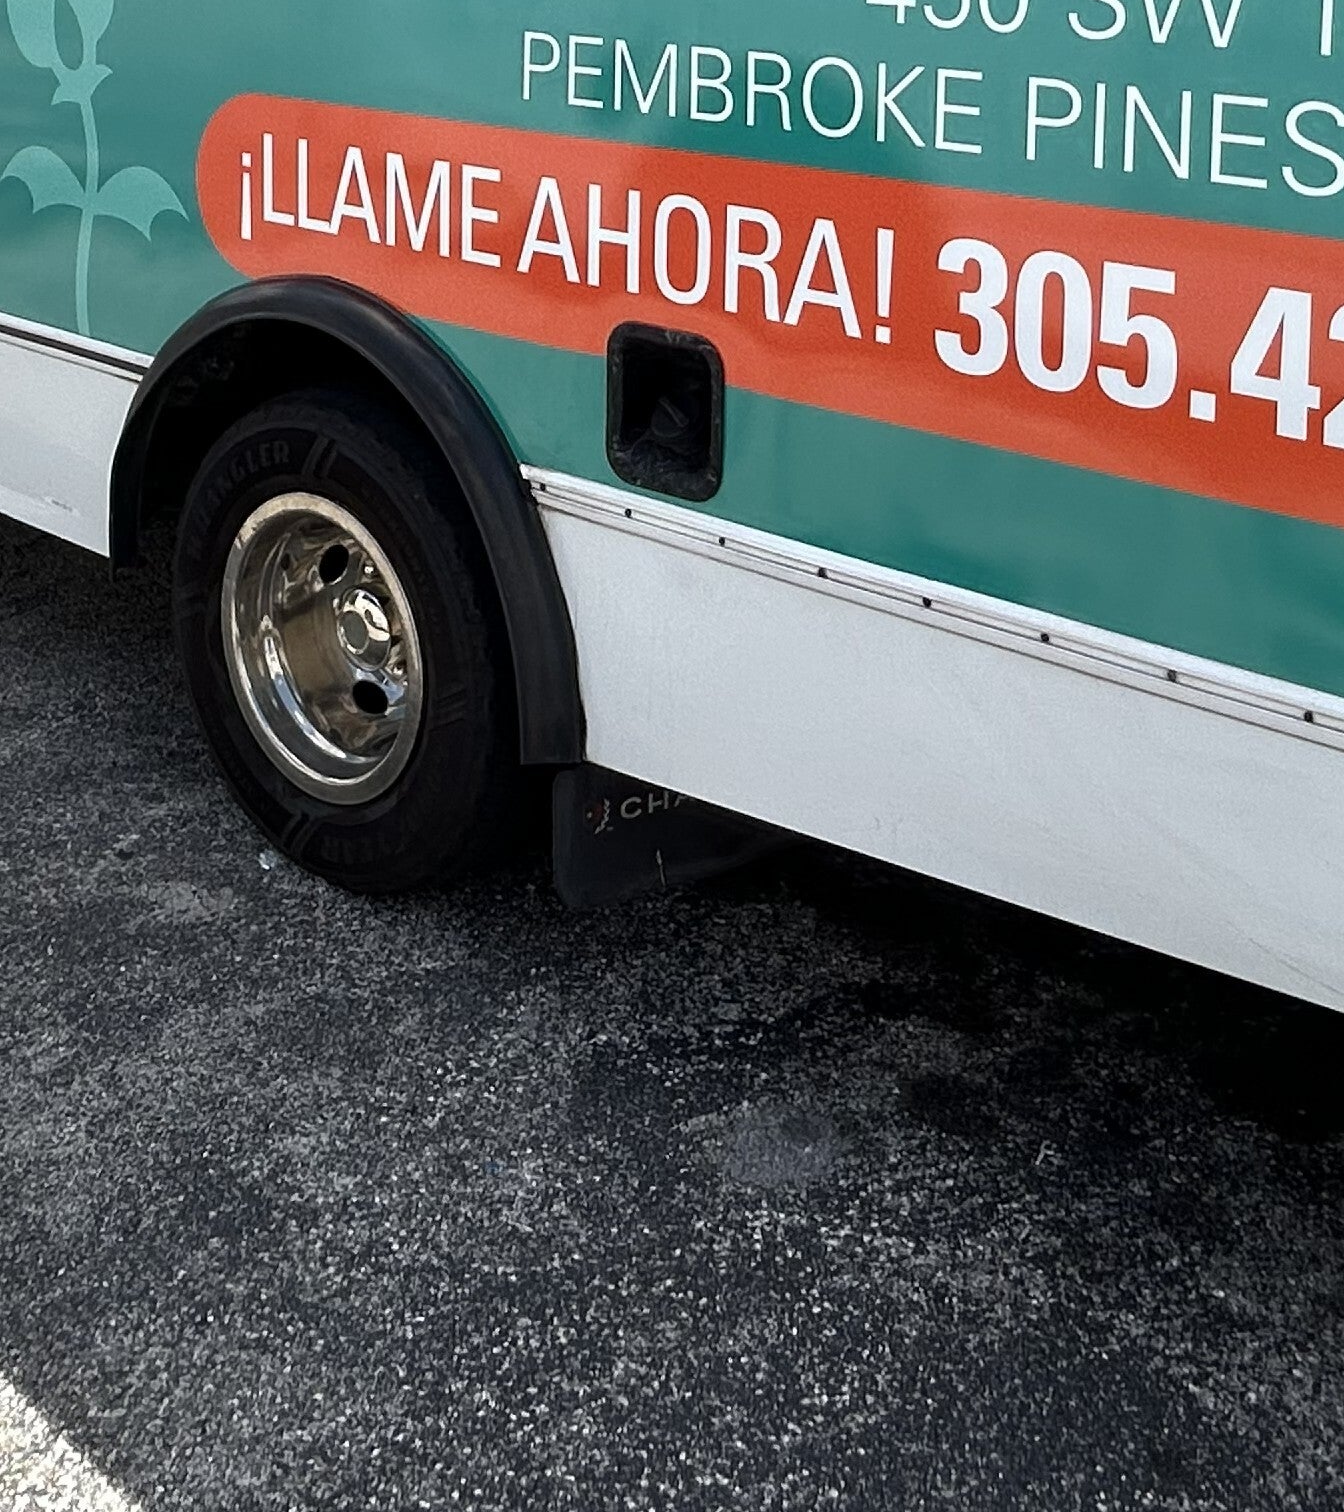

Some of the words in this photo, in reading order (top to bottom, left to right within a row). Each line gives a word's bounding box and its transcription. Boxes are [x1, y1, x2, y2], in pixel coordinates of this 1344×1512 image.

[521, 31, 983, 154] PEMBROKE
[241, 132, 501, 268] ¡LLAME
[517, 177, 895, 345] AHORA!
